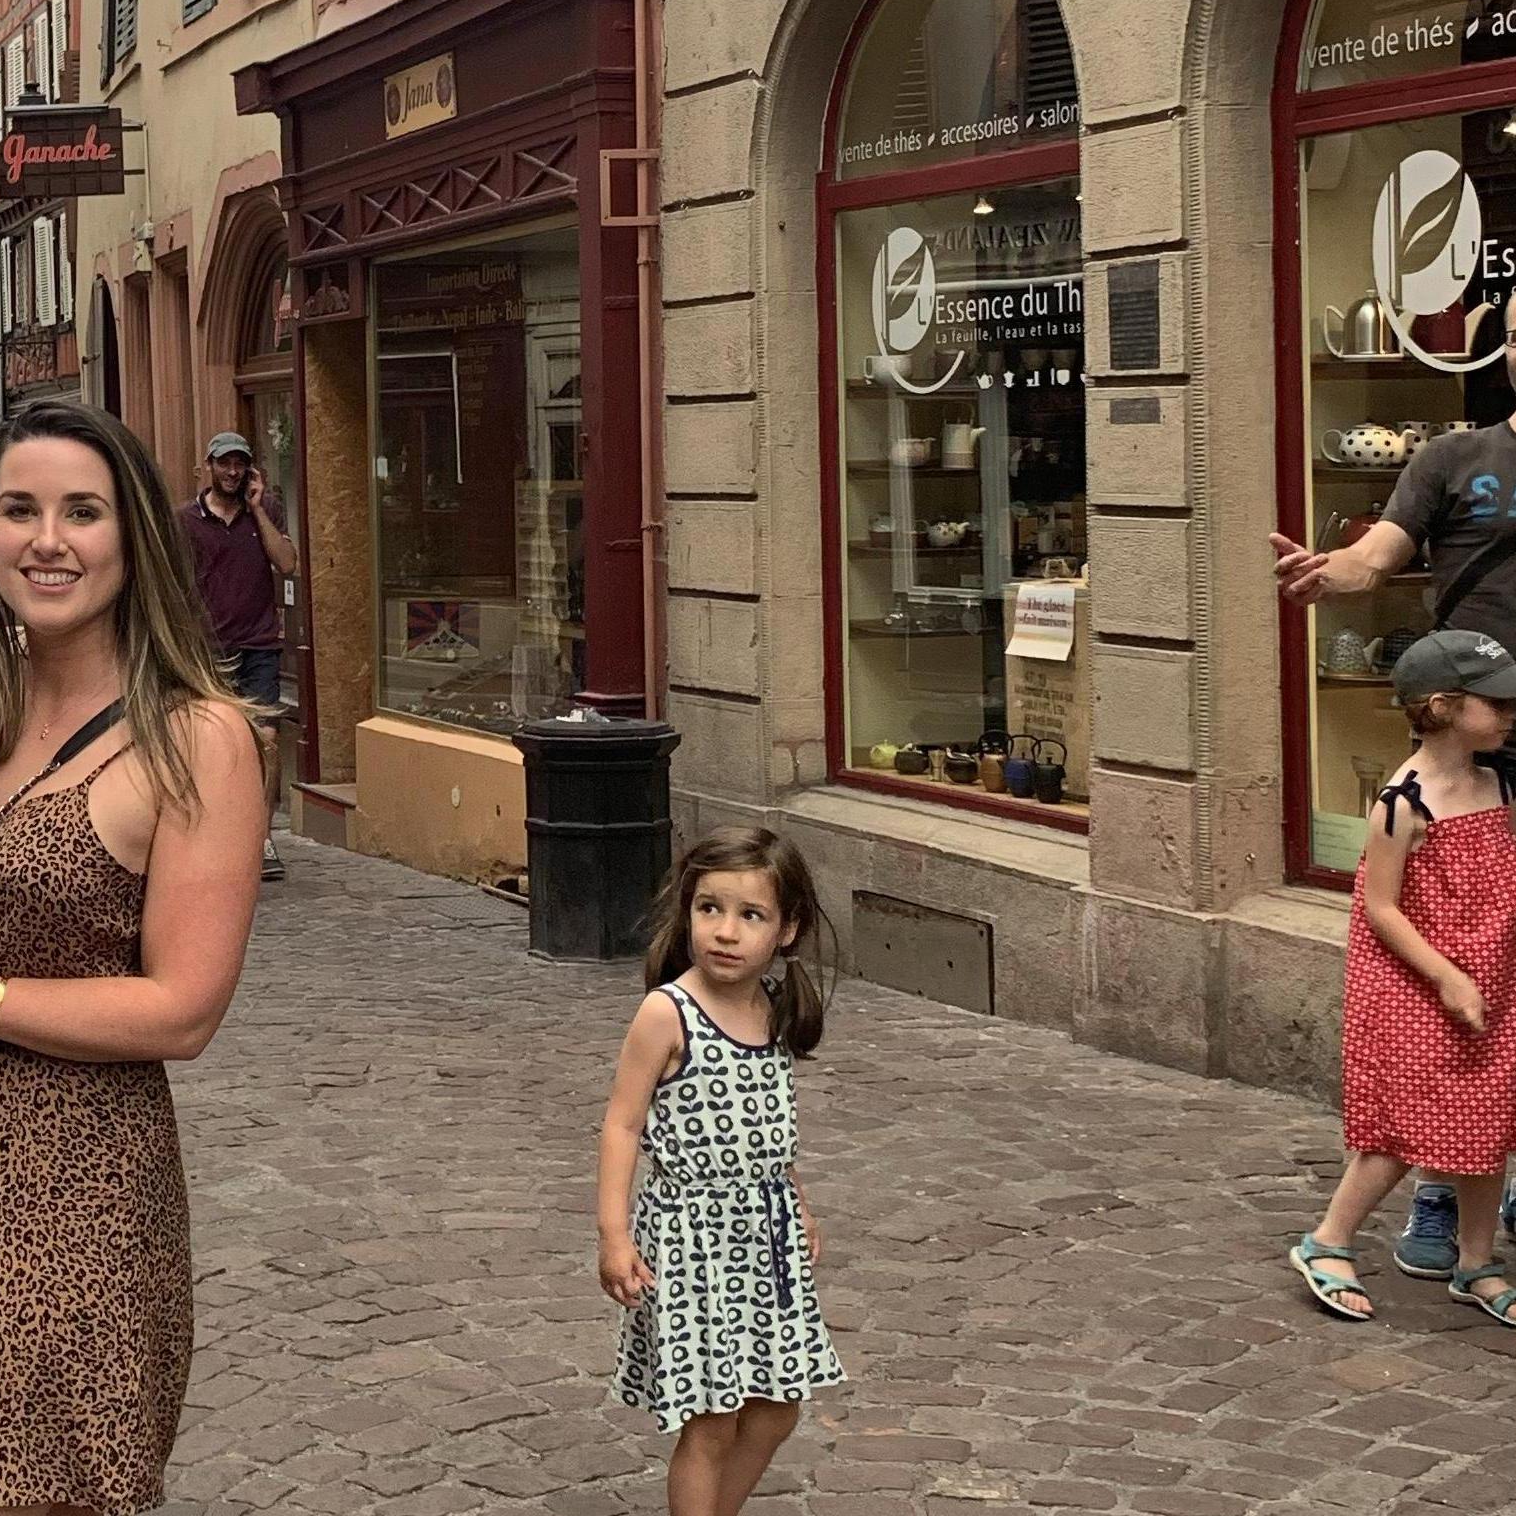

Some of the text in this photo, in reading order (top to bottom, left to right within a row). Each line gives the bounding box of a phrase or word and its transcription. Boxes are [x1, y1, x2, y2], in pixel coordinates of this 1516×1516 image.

[1306, 38, 1365, 68] vente
[1371, 26, 1399, 58] de
[1405, 16, 1454, 52] thés
[401, 76, 433, 124] Jana
[838, 100, 1079, 165] vente de thés accessoires salon
[1021, 284, 1048, 318] du
[935, 331, 947, 344] La
[996, 325, 1025, 339] l'eau
[1030, 324, 1042, 336] et
[1047, 321, 1058, 335] la
